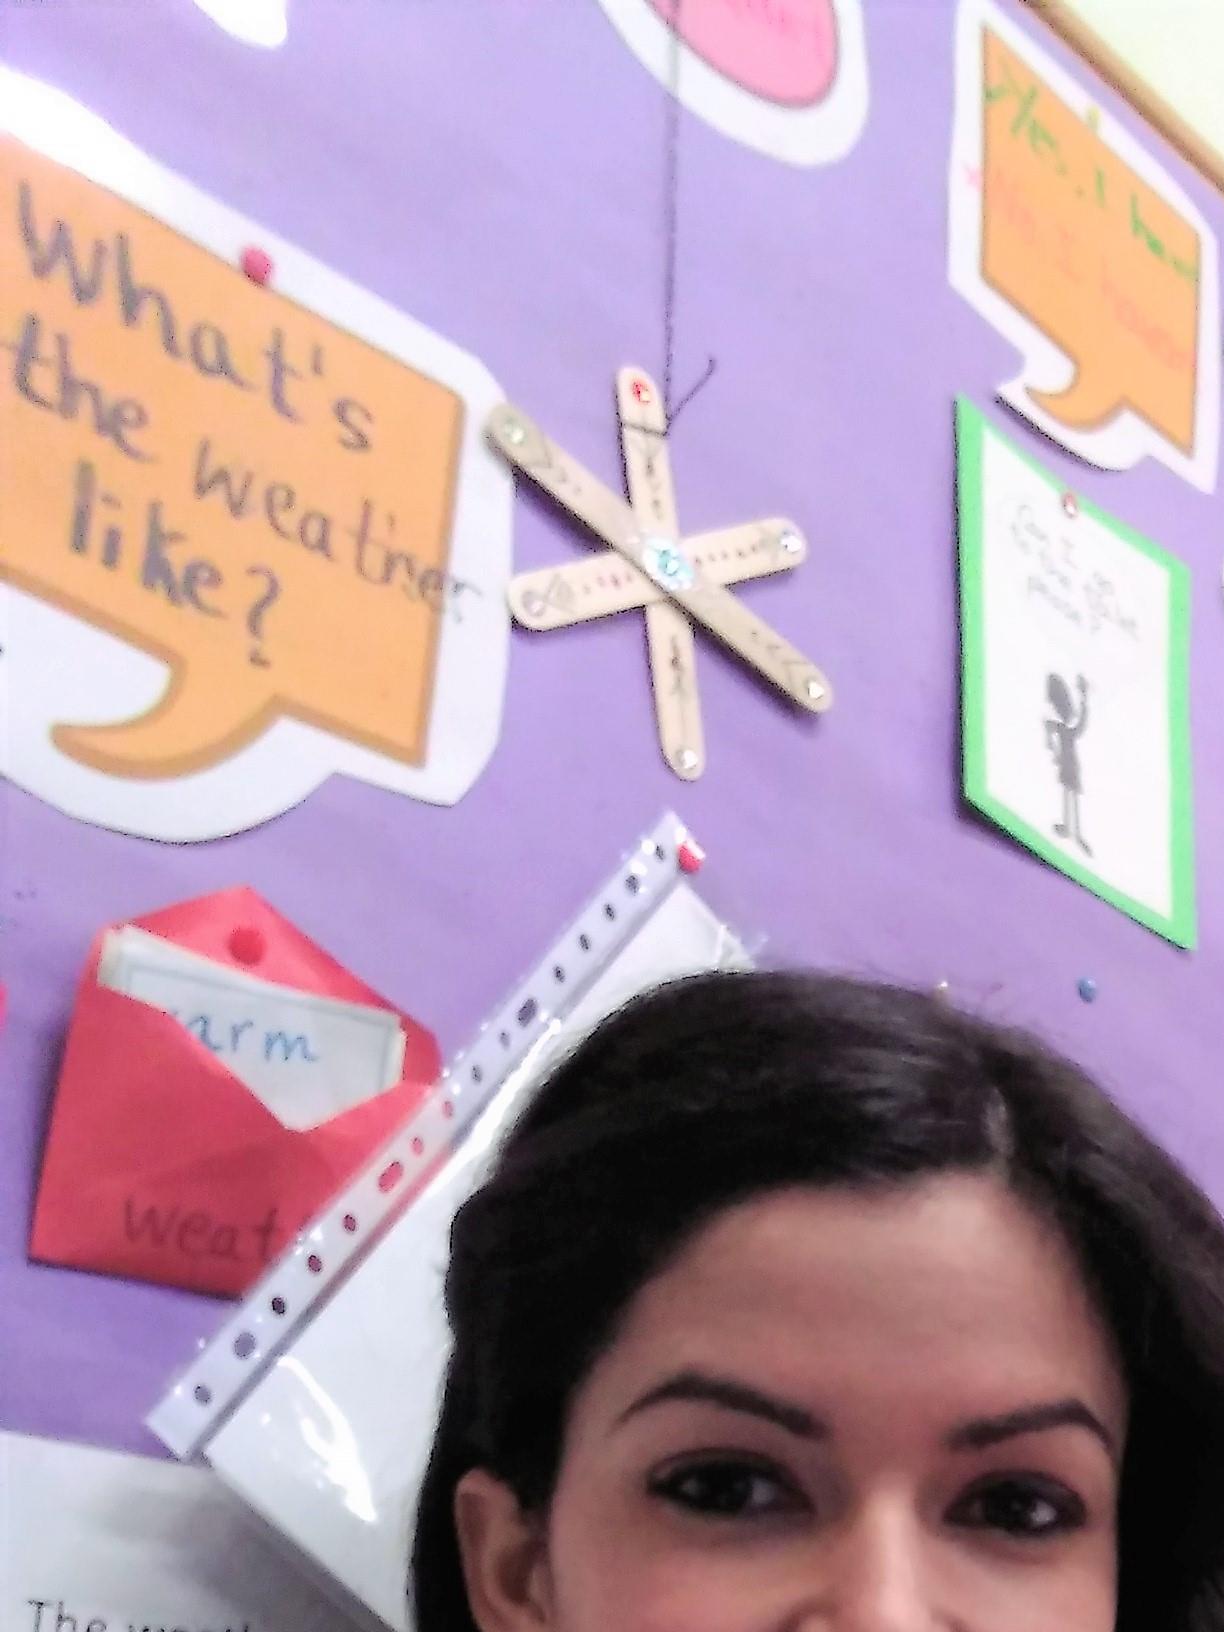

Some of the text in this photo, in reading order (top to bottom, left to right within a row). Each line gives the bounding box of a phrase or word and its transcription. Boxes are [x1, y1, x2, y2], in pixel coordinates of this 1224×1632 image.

[0, 312, 158, 463] the
[18, 180, 374, 452] What's
[70, 459, 282, 669] like?
[172, 1010, 320, 1064] arm
[122, 1192, 284, 1264] weat
